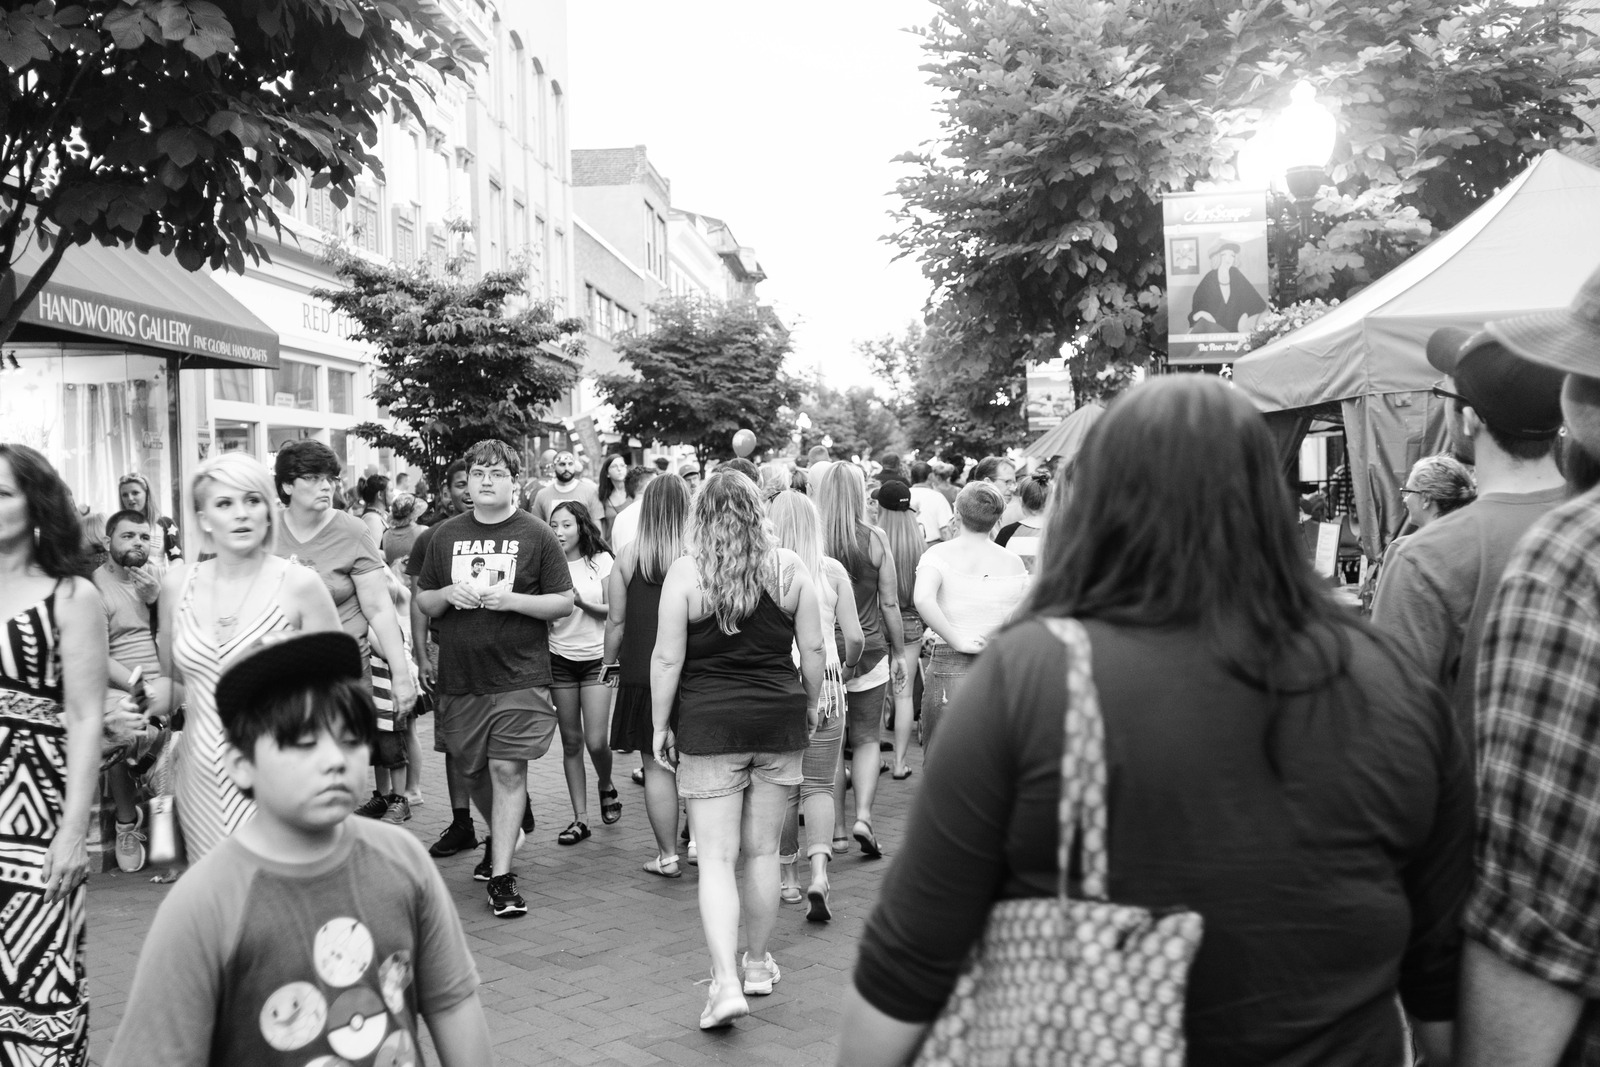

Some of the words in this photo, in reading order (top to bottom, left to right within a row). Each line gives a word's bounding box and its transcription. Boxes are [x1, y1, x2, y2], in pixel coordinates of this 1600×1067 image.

[39, 291, 136, 337] HANDWORKS
[139, 314, 192, 347] GALLERY
[193, 335, 208, 351] FINE
[208, 338, 232, 356] GLOBAL
[232, 344, 268, 363] HANDCRAFTS
[302, 302, 330, 333] RED
[452, 540, 496, 555] FEAR
[501, 539, 520, 554] IS
